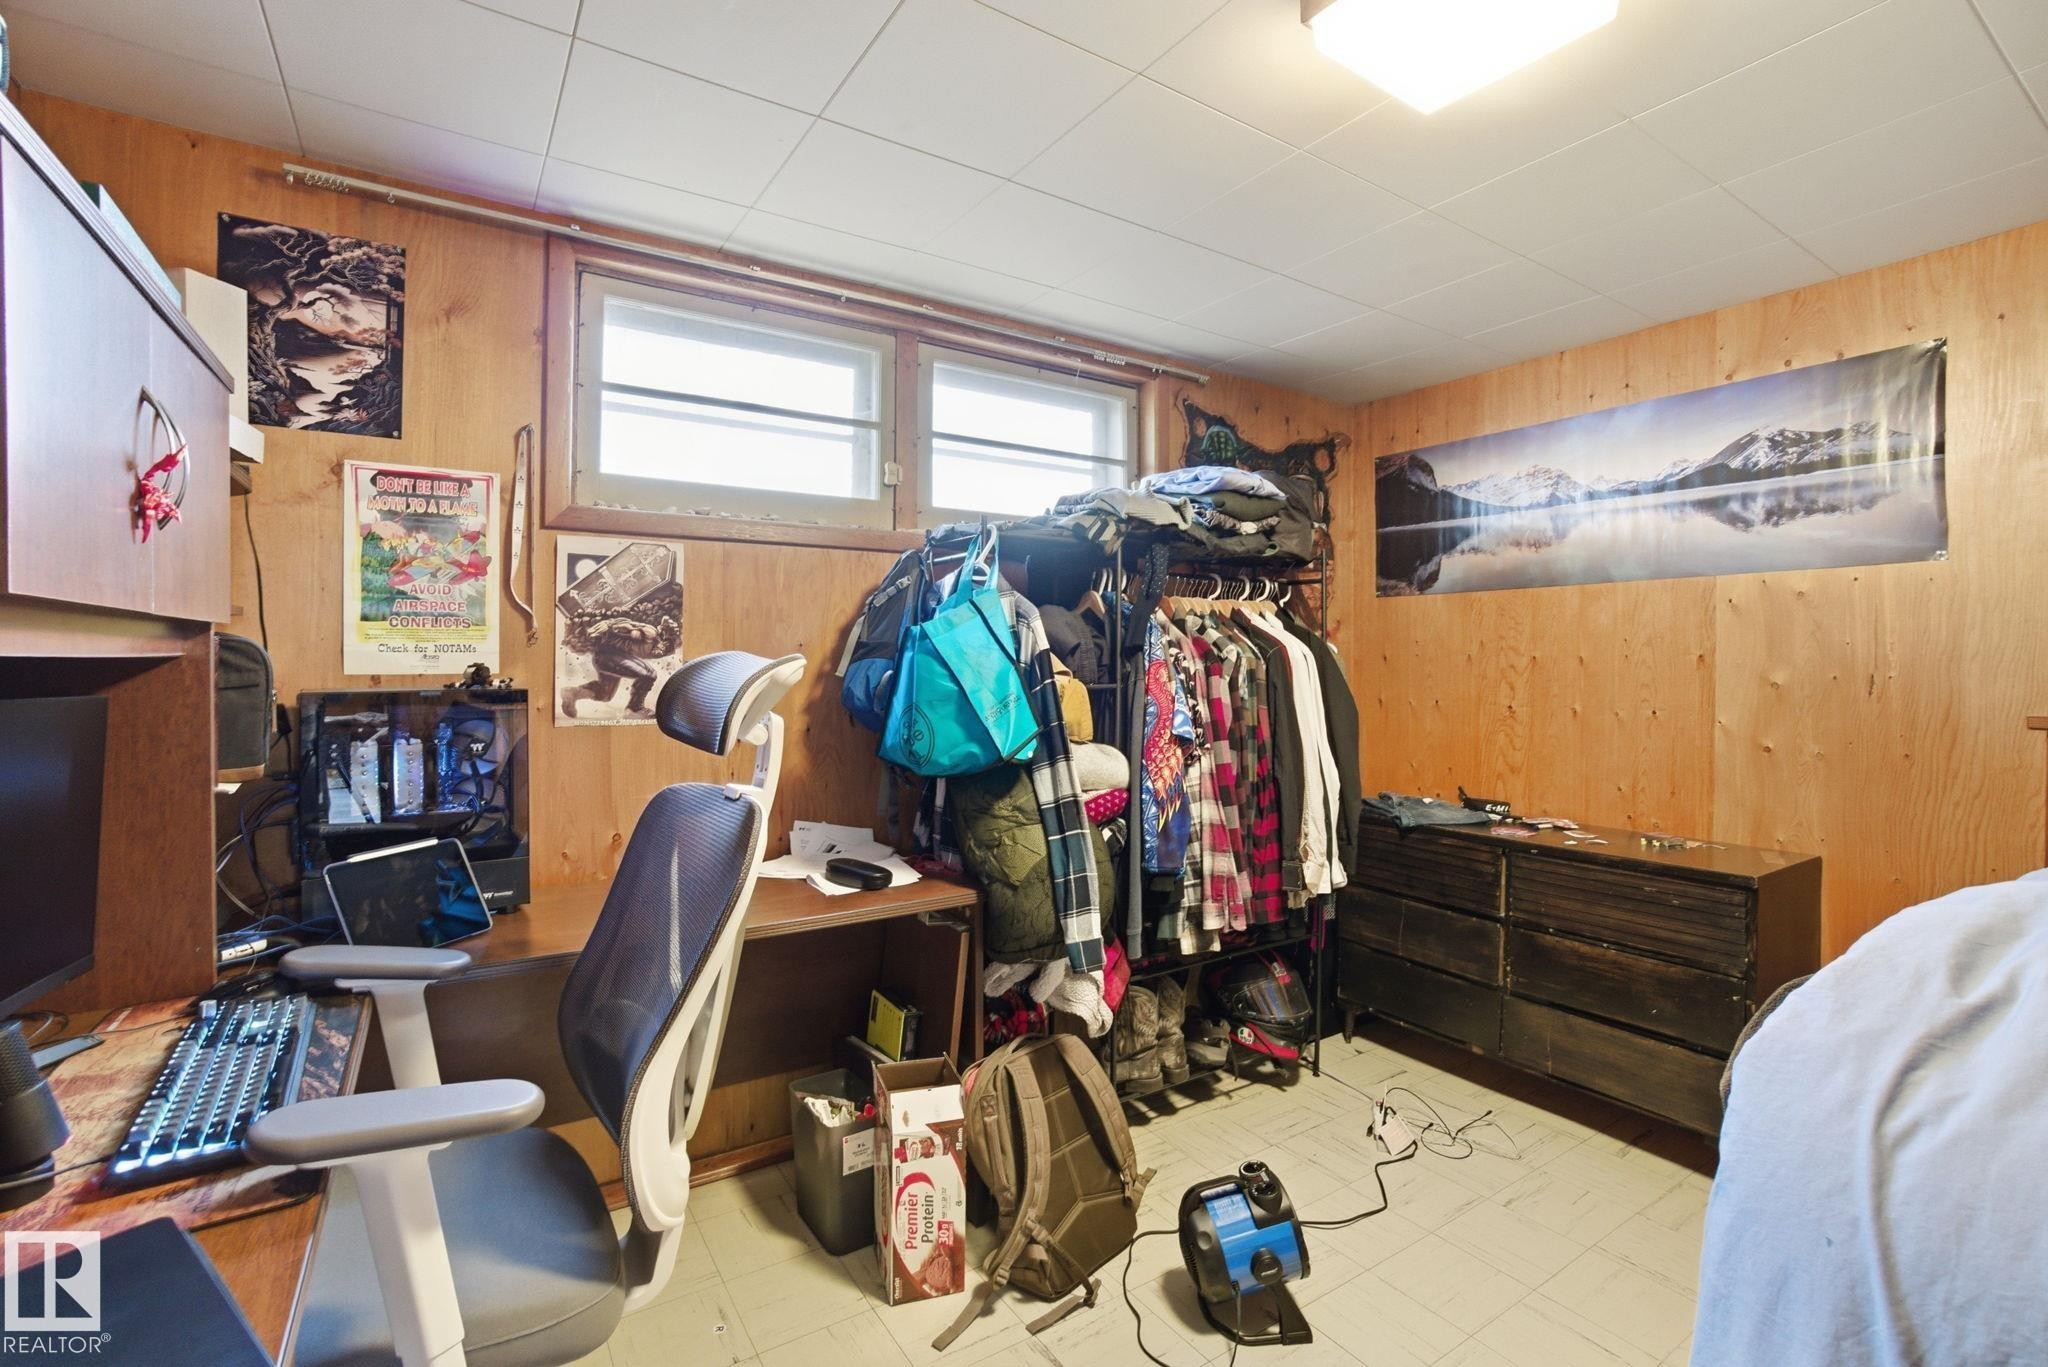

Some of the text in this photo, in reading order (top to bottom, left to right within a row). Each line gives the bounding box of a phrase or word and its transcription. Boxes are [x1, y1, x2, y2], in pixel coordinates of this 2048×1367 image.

[377, 476, 468, 497] DON'T BE LIKE A
[367, 495, 477, 516] MOTH TO A FLAME
[410, 584, 452, 595] AVOID
[393, 599, 466, 612] AIRSPACE
[389, 615, 471, 628] CONFLICTS
[378, 643, 476, 653] Check for NOTAMs
[905, 1192, 918, 1250] Premier
[922, 1194, 934, 1243] Protein
